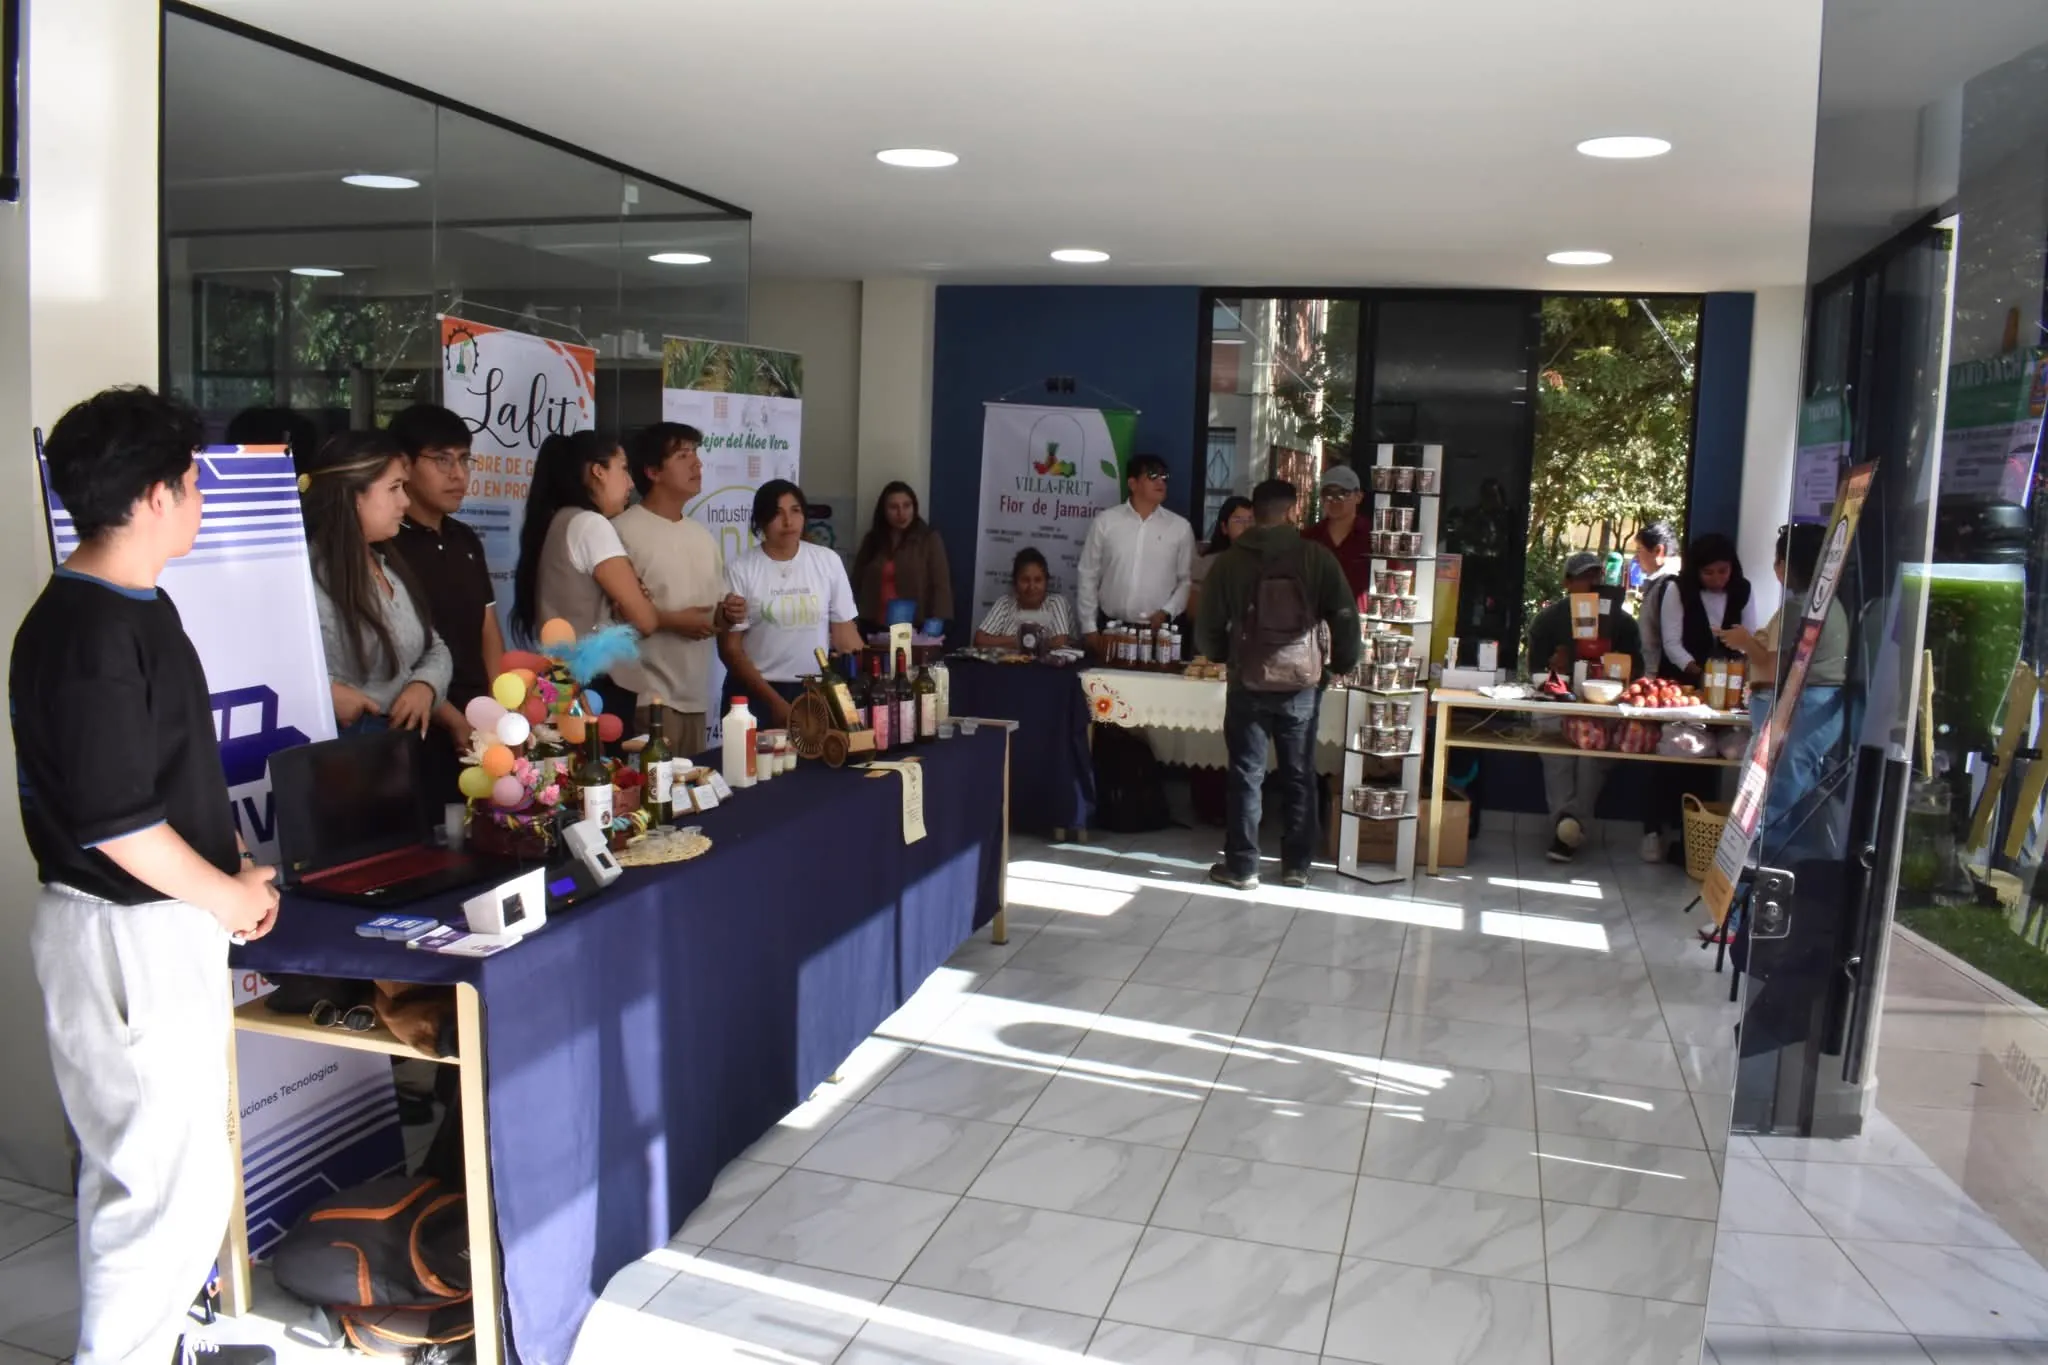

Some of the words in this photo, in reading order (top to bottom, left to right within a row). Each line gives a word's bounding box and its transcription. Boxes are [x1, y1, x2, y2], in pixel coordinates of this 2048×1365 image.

[461, 368, 577, 449] Lafit
[726, 432, 743, 449] del
[475, 454, 501, 473] BRE
[505, 457, 522, 475] DE
[484, 480, 500, 497] EN
[1016, 476, 1093, 496] VILLA-FRUT
[1000, 495, 1024, 513] Flor
[1032, 497, 1047, 515] de
[1054, 499, 1106, 520] Jamaic
